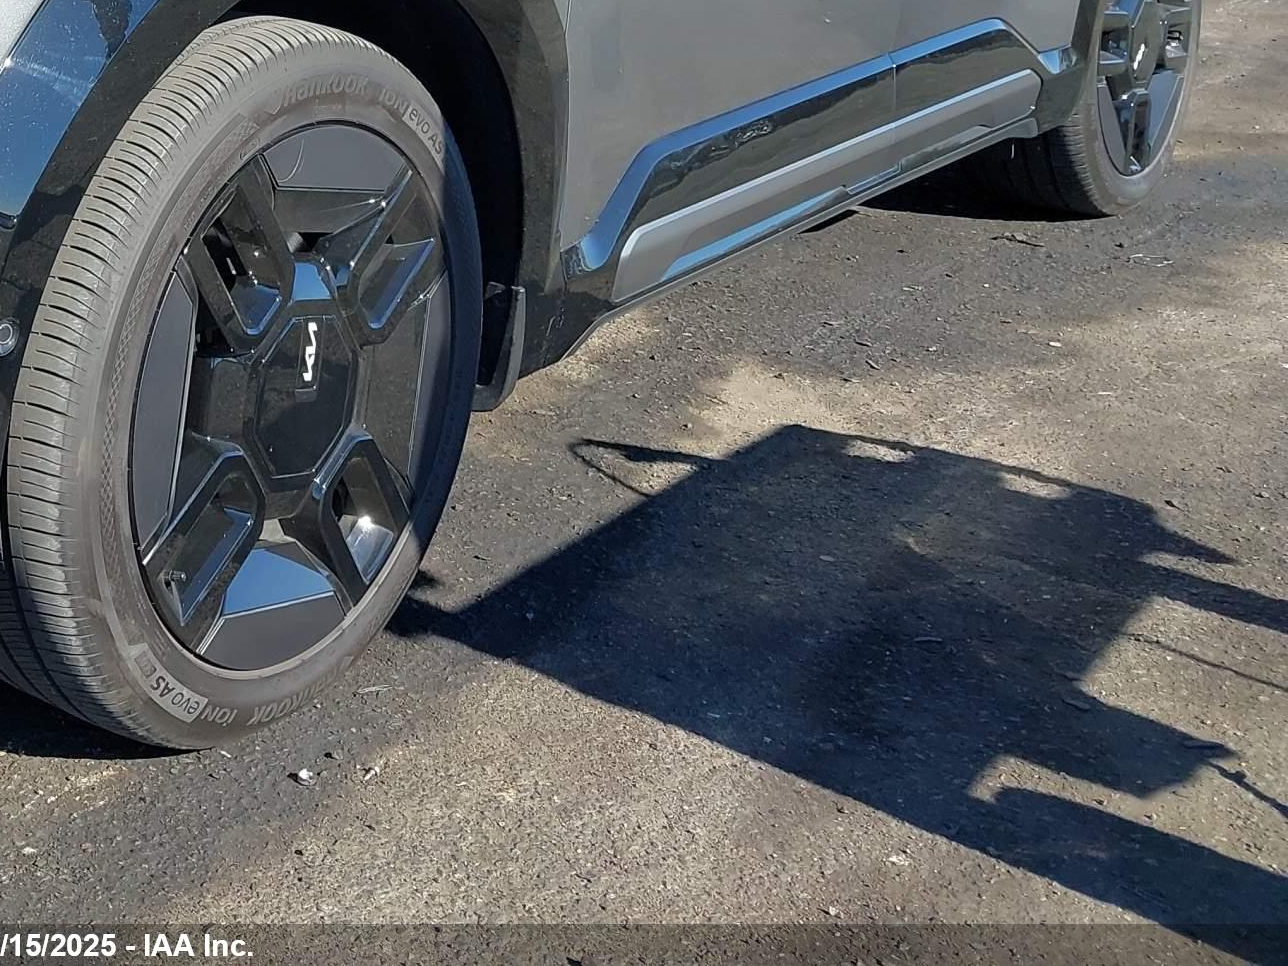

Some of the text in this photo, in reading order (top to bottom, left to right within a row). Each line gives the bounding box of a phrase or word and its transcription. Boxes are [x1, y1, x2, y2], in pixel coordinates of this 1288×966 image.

[428, 134, 443, 155] AS
[150, 676, 176, 698] AS
[172, 692, 200, 715] evo
